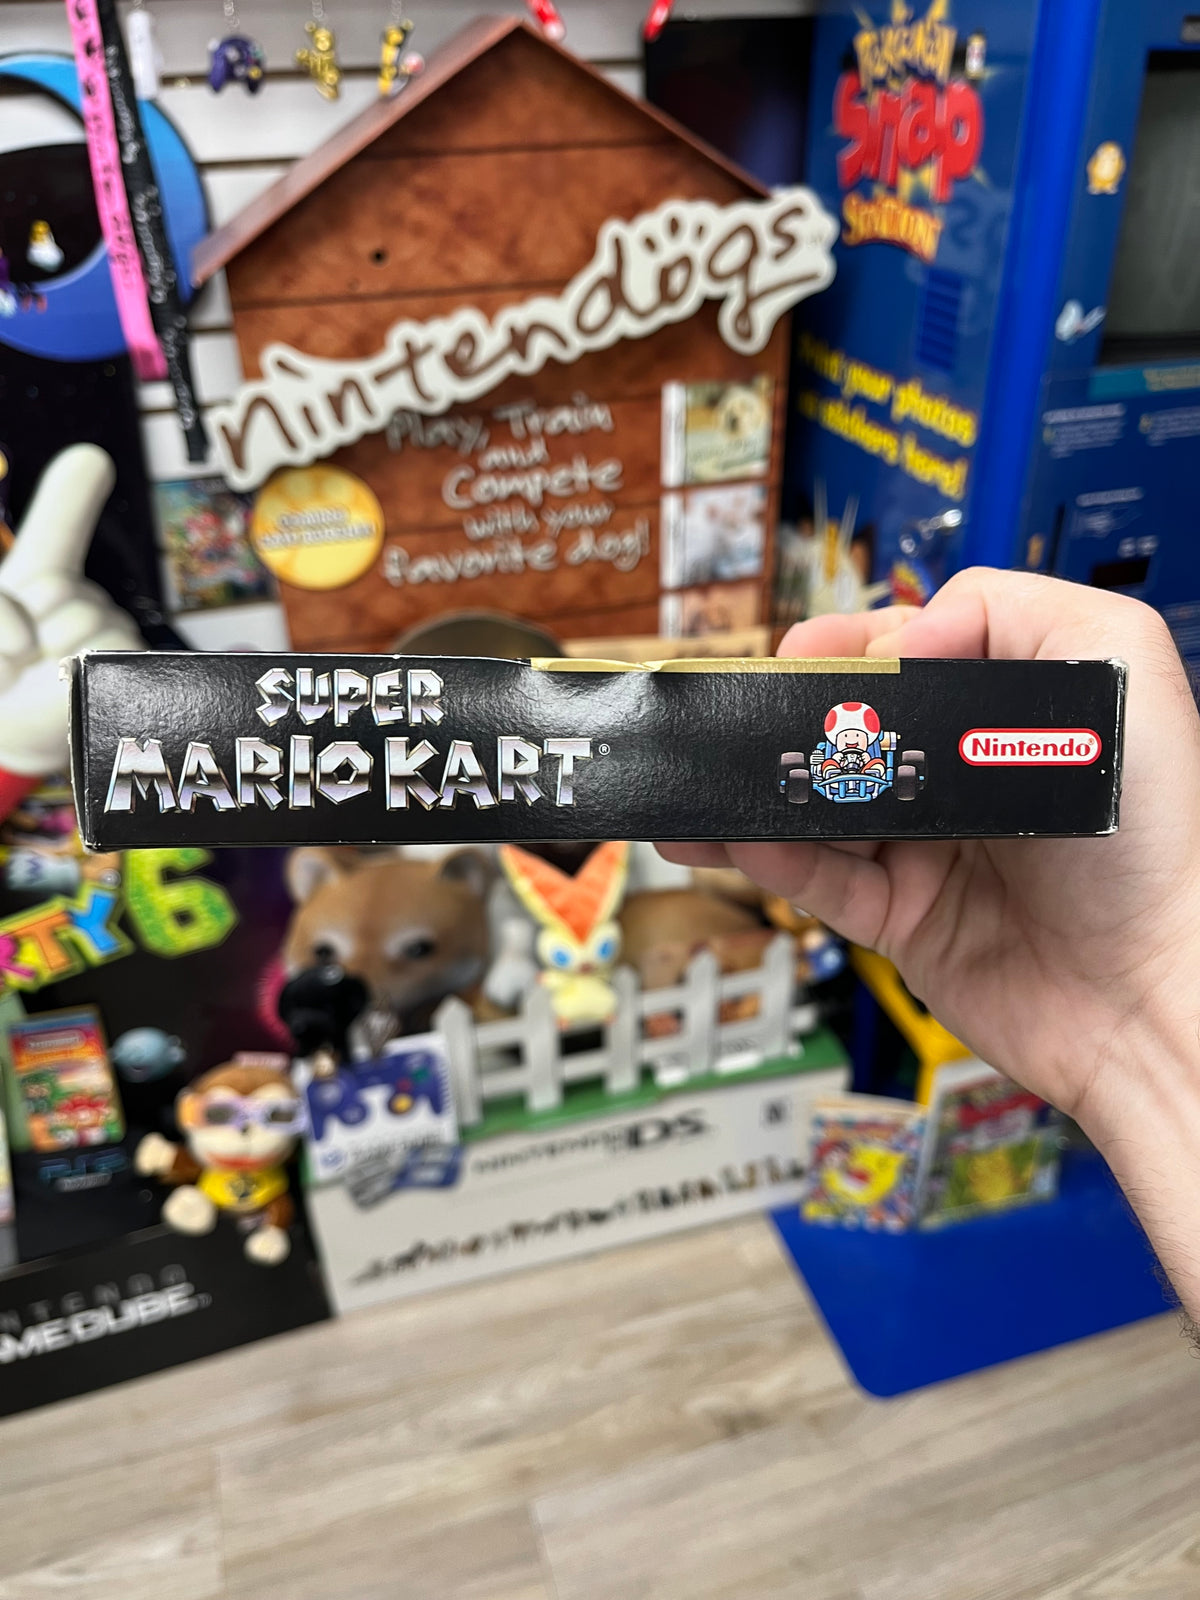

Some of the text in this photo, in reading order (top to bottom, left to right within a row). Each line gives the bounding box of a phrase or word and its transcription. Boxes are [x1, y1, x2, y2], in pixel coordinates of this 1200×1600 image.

[833, 70, 984, 203] Snap
[220, 206, 821, 473] nintendogs
[494, 390, 614, 439] Train
[891, 376, 977, 448] photos
[442, 454, 623, 510] Compete
[478, 435, 548, 471] and
[463, 501, 614, 540] with your
[565, 515, 650, 572] dog!
[255, 667, 446, 727] SUPER
[104, 735, 374, 813] MARIO
[126, 848, 239, 958] 6
